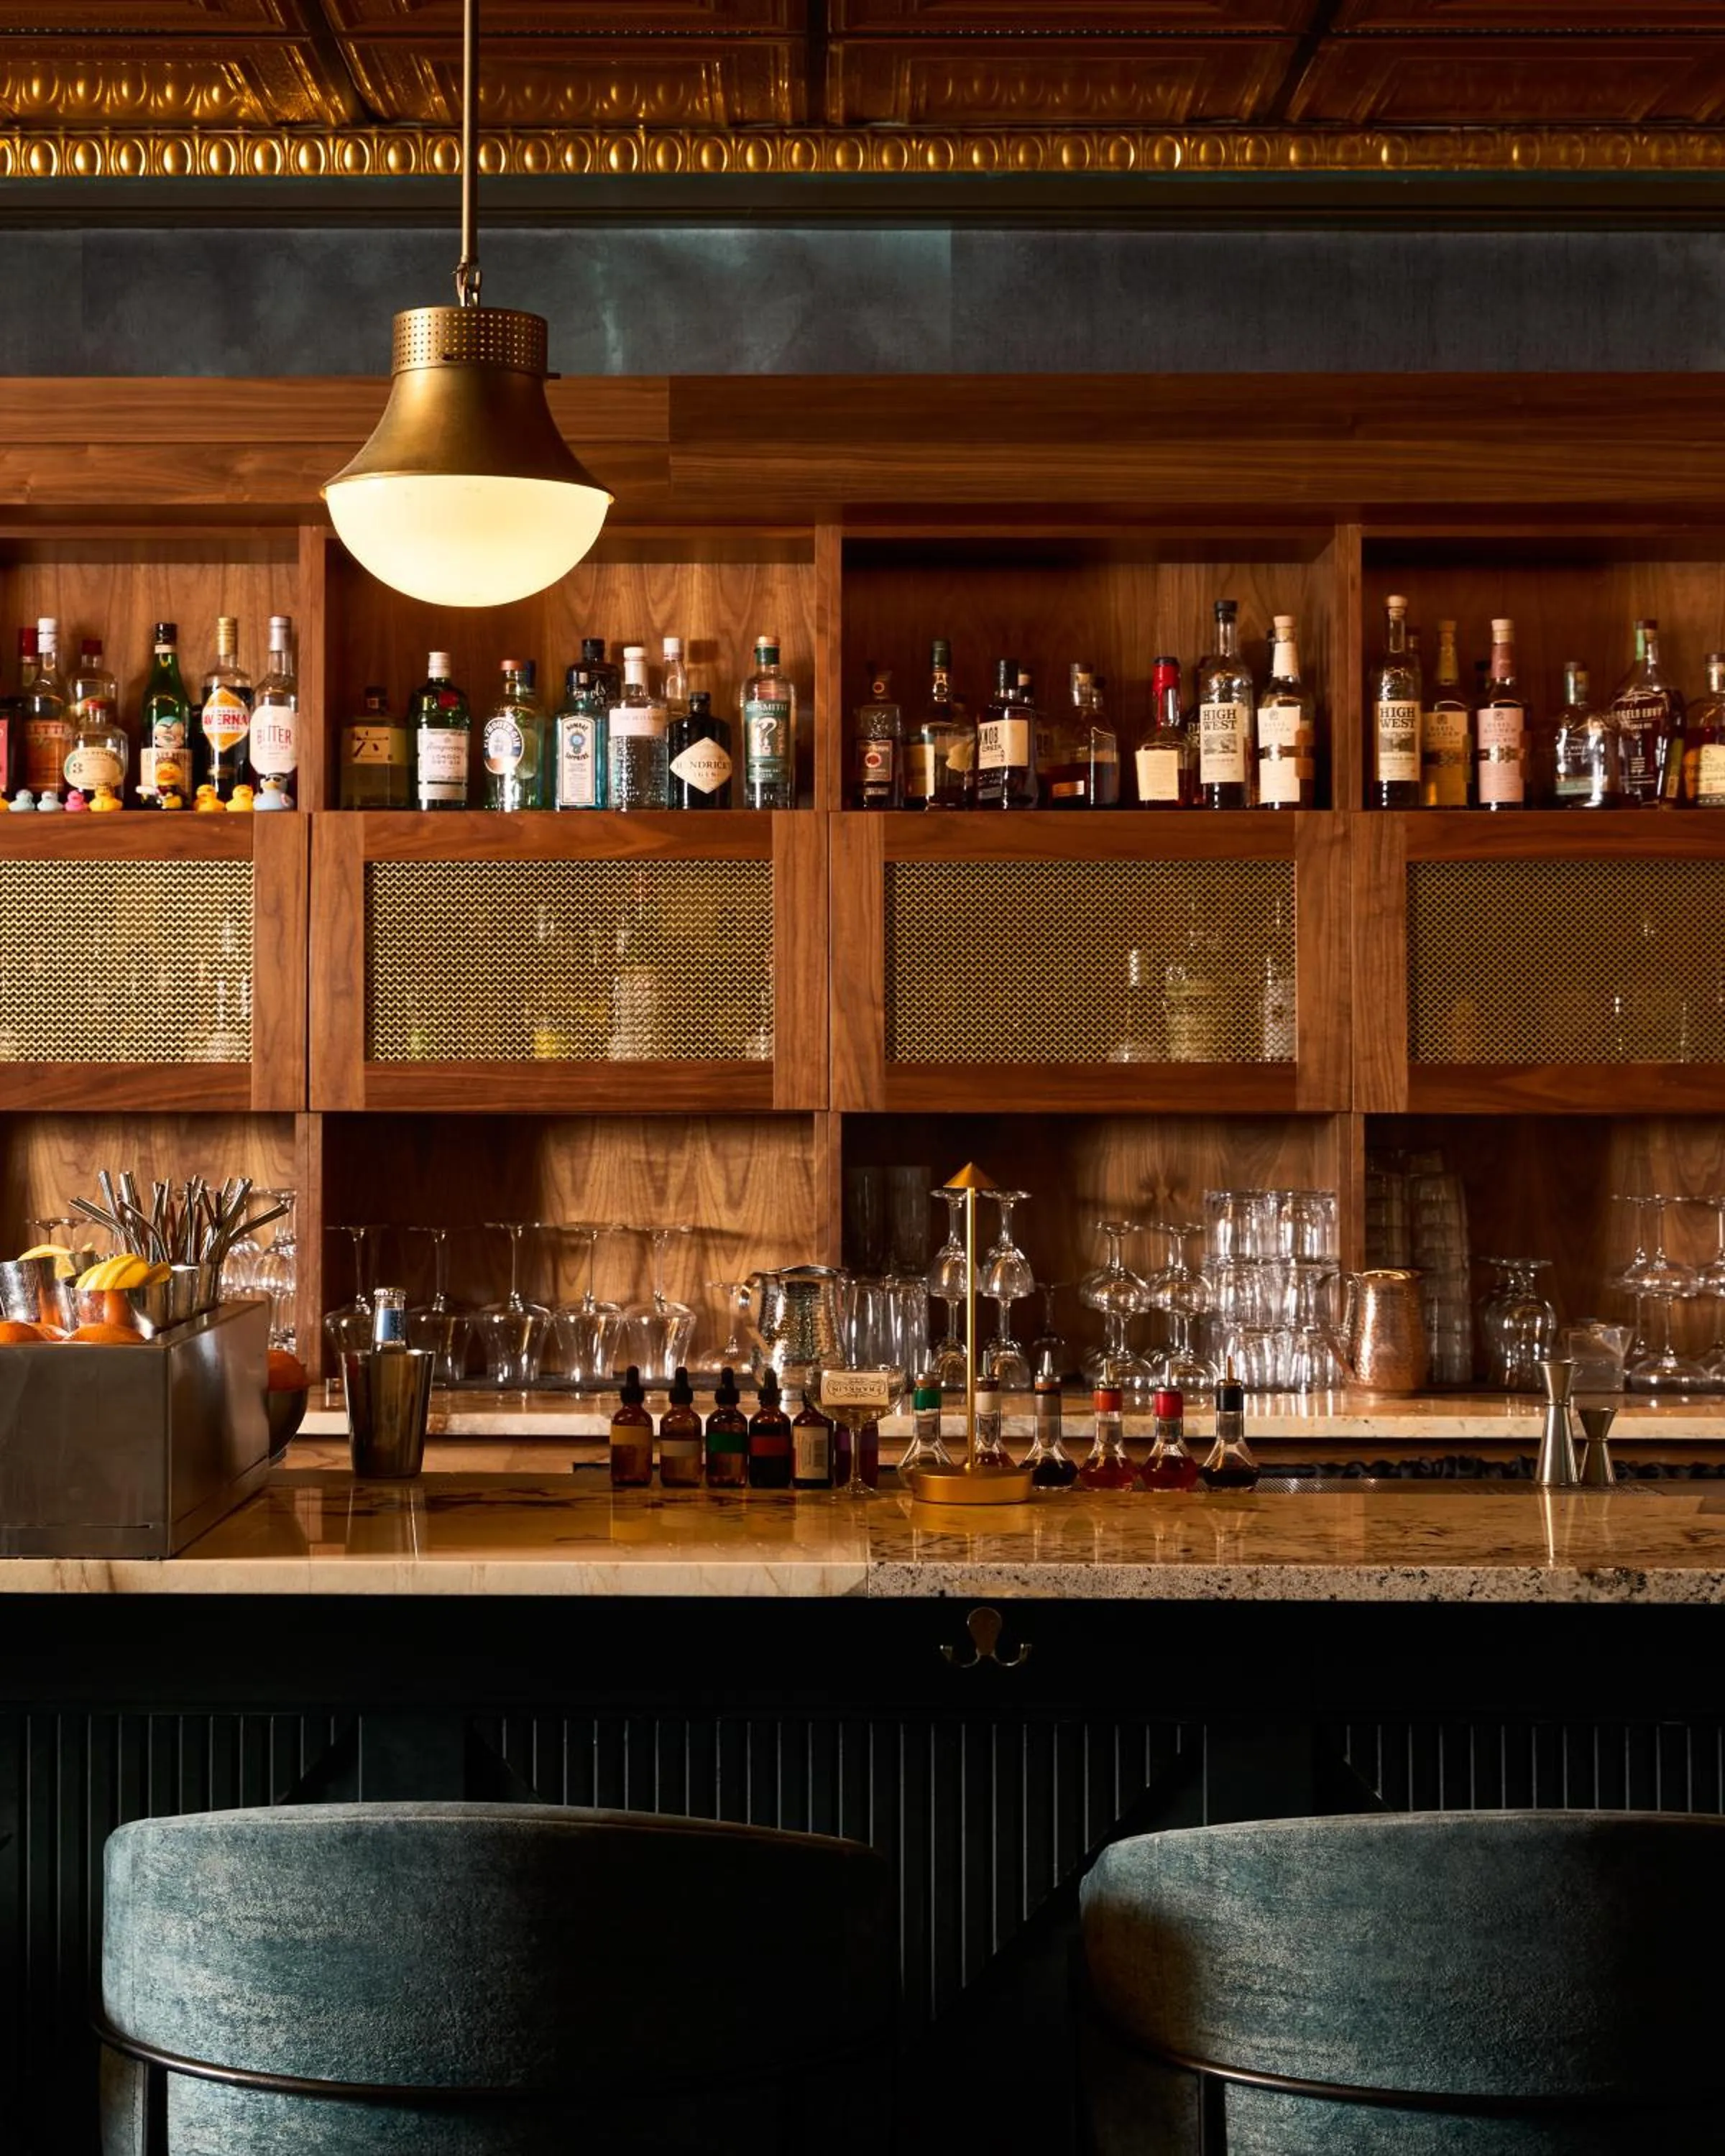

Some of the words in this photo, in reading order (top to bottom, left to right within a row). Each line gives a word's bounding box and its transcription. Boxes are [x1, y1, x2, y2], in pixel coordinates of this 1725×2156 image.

[1202, 707, 1236, 720] HIGH
[1379, 706, 1414, 718] HIGH
[1202, 719, 1236, 731] WEST
[1379, 718, 1414, 728] WEST
[256, 724, 292, 745] BITTER
